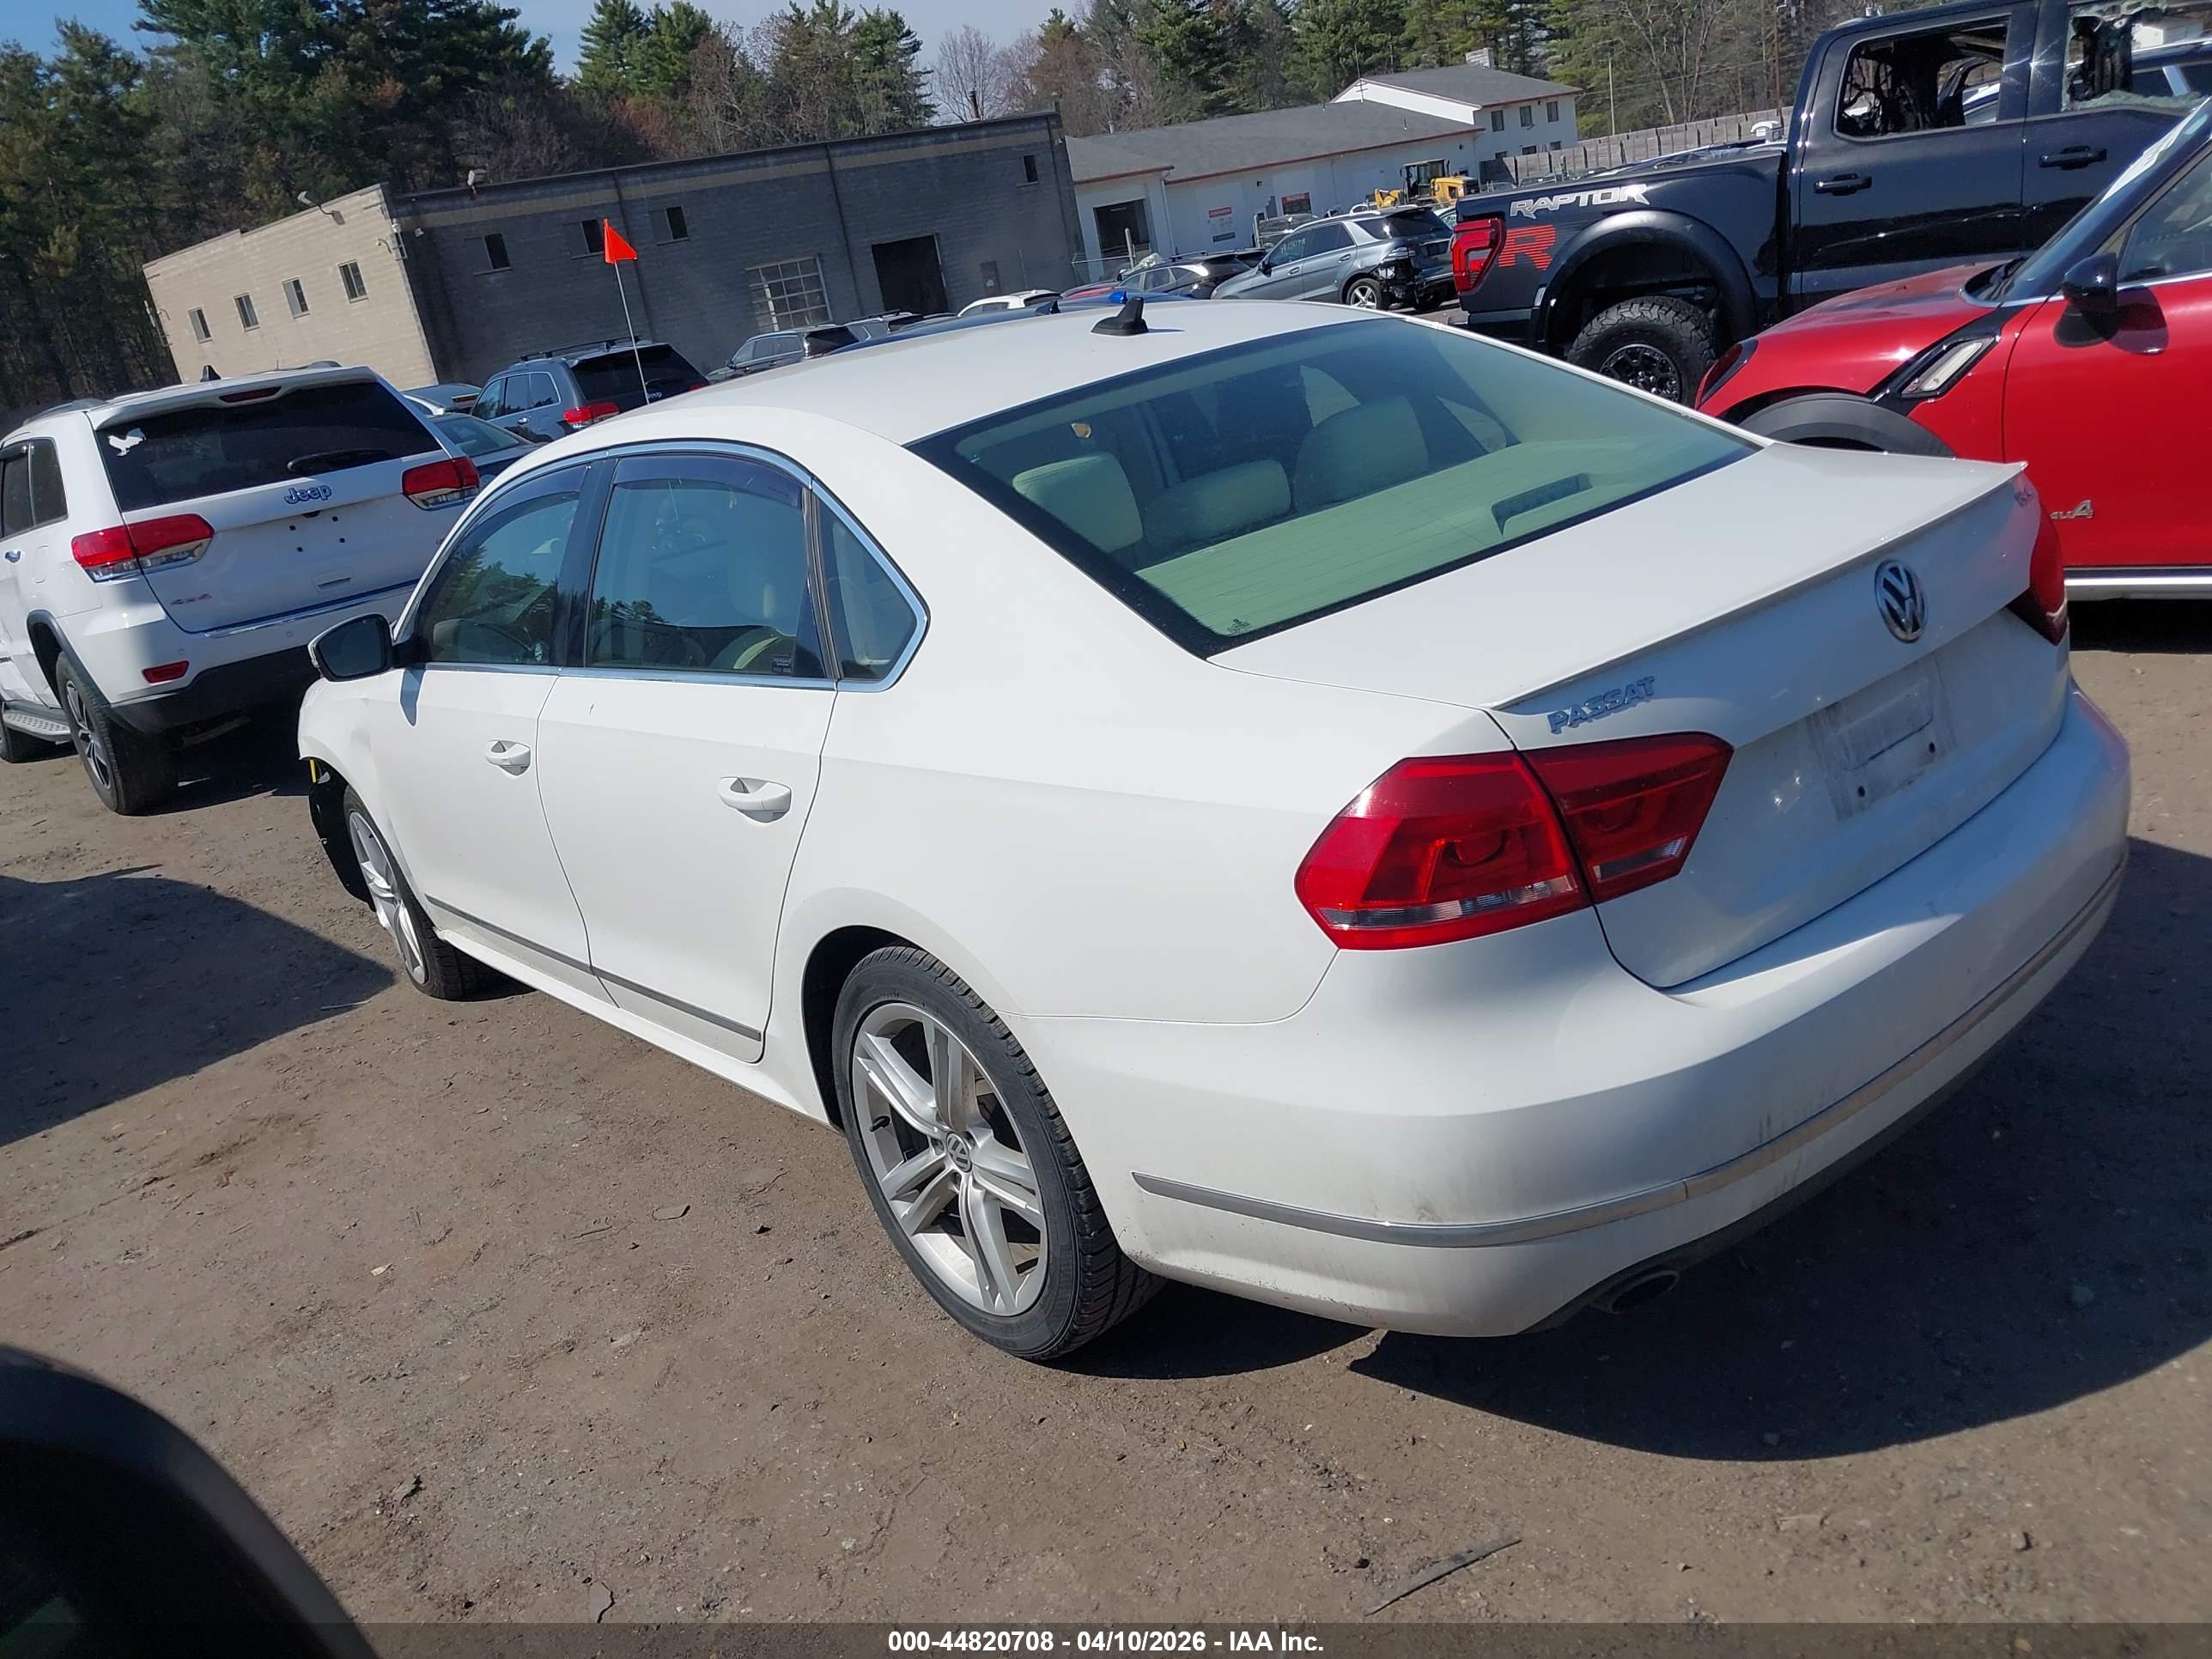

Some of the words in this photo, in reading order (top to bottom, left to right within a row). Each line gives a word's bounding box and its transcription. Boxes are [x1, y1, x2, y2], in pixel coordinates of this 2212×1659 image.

[1510, 184, 1650, 219] RAPTOR
[1498, 224, 1557, 270] R
[284, 485, 331, 504] Jeep
[1547, 676, 1655, 734] PASSAT
